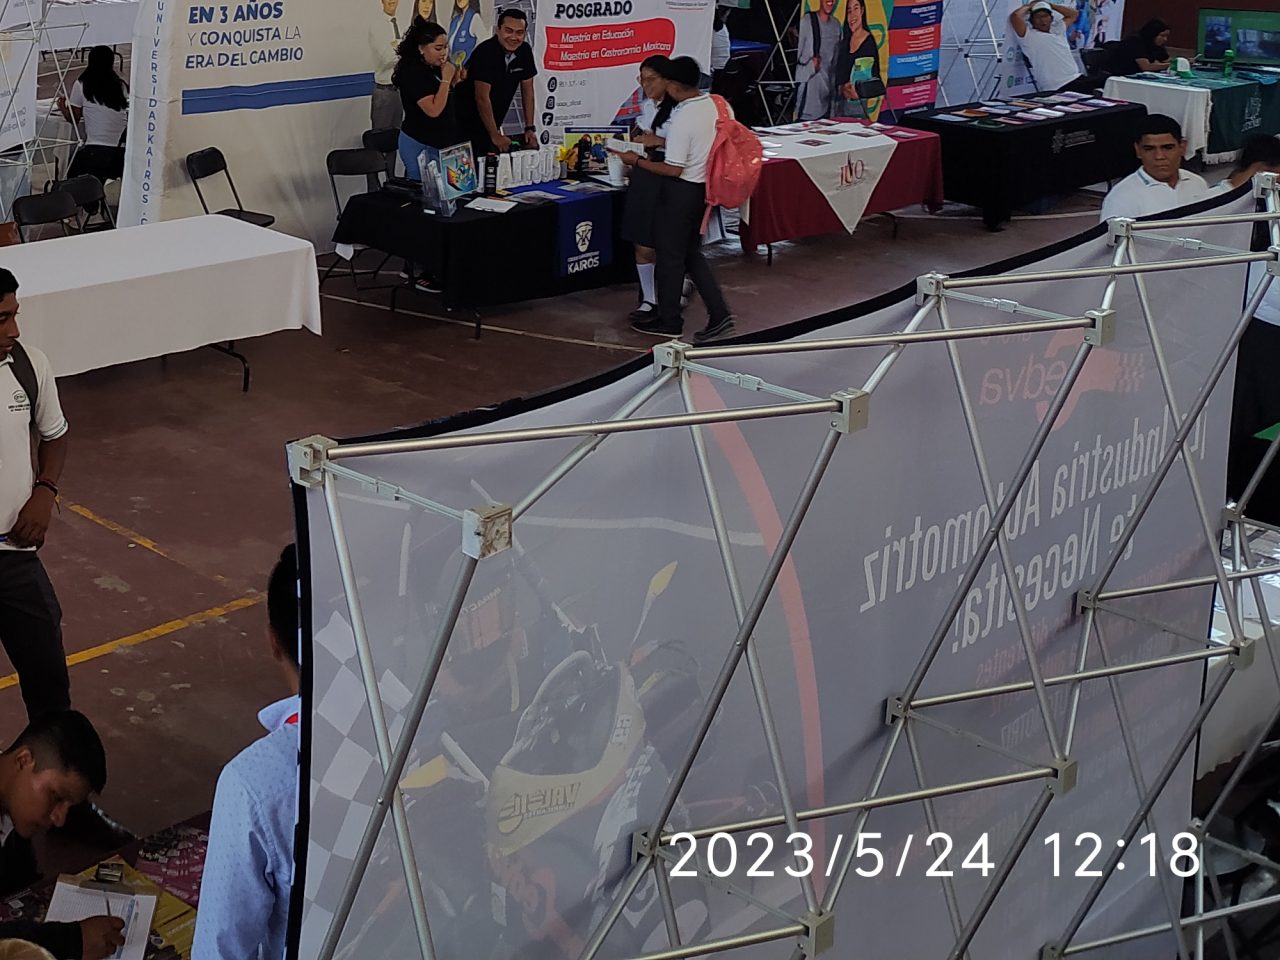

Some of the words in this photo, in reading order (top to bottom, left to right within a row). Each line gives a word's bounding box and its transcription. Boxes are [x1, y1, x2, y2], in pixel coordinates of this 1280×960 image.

[188, 6, 215, 24] EN
[220, 5, 228, 23] 3
[554, 0, 633, 20] POSGRADO
[187, 33, 197, 46] Y
[200, 26, 282, 46] CONQUISTA
[285, 25, 301, 40] LA
[561, 31, 591, 44] Maestría
[592, 33, 601, 41] en
[601, 28, 634, 41] Educación
[185, 54, 214, 69] ERA
[217, 52, 248, 67] DEL
[249, 47, 304, 65] CAMBIO
[560, 49, 590, 62] Maestría
[591, 50, 600, 59] en
[600, 45, 641, 58] Gastronomía
[643, 42, 671, 53] Mexicana
